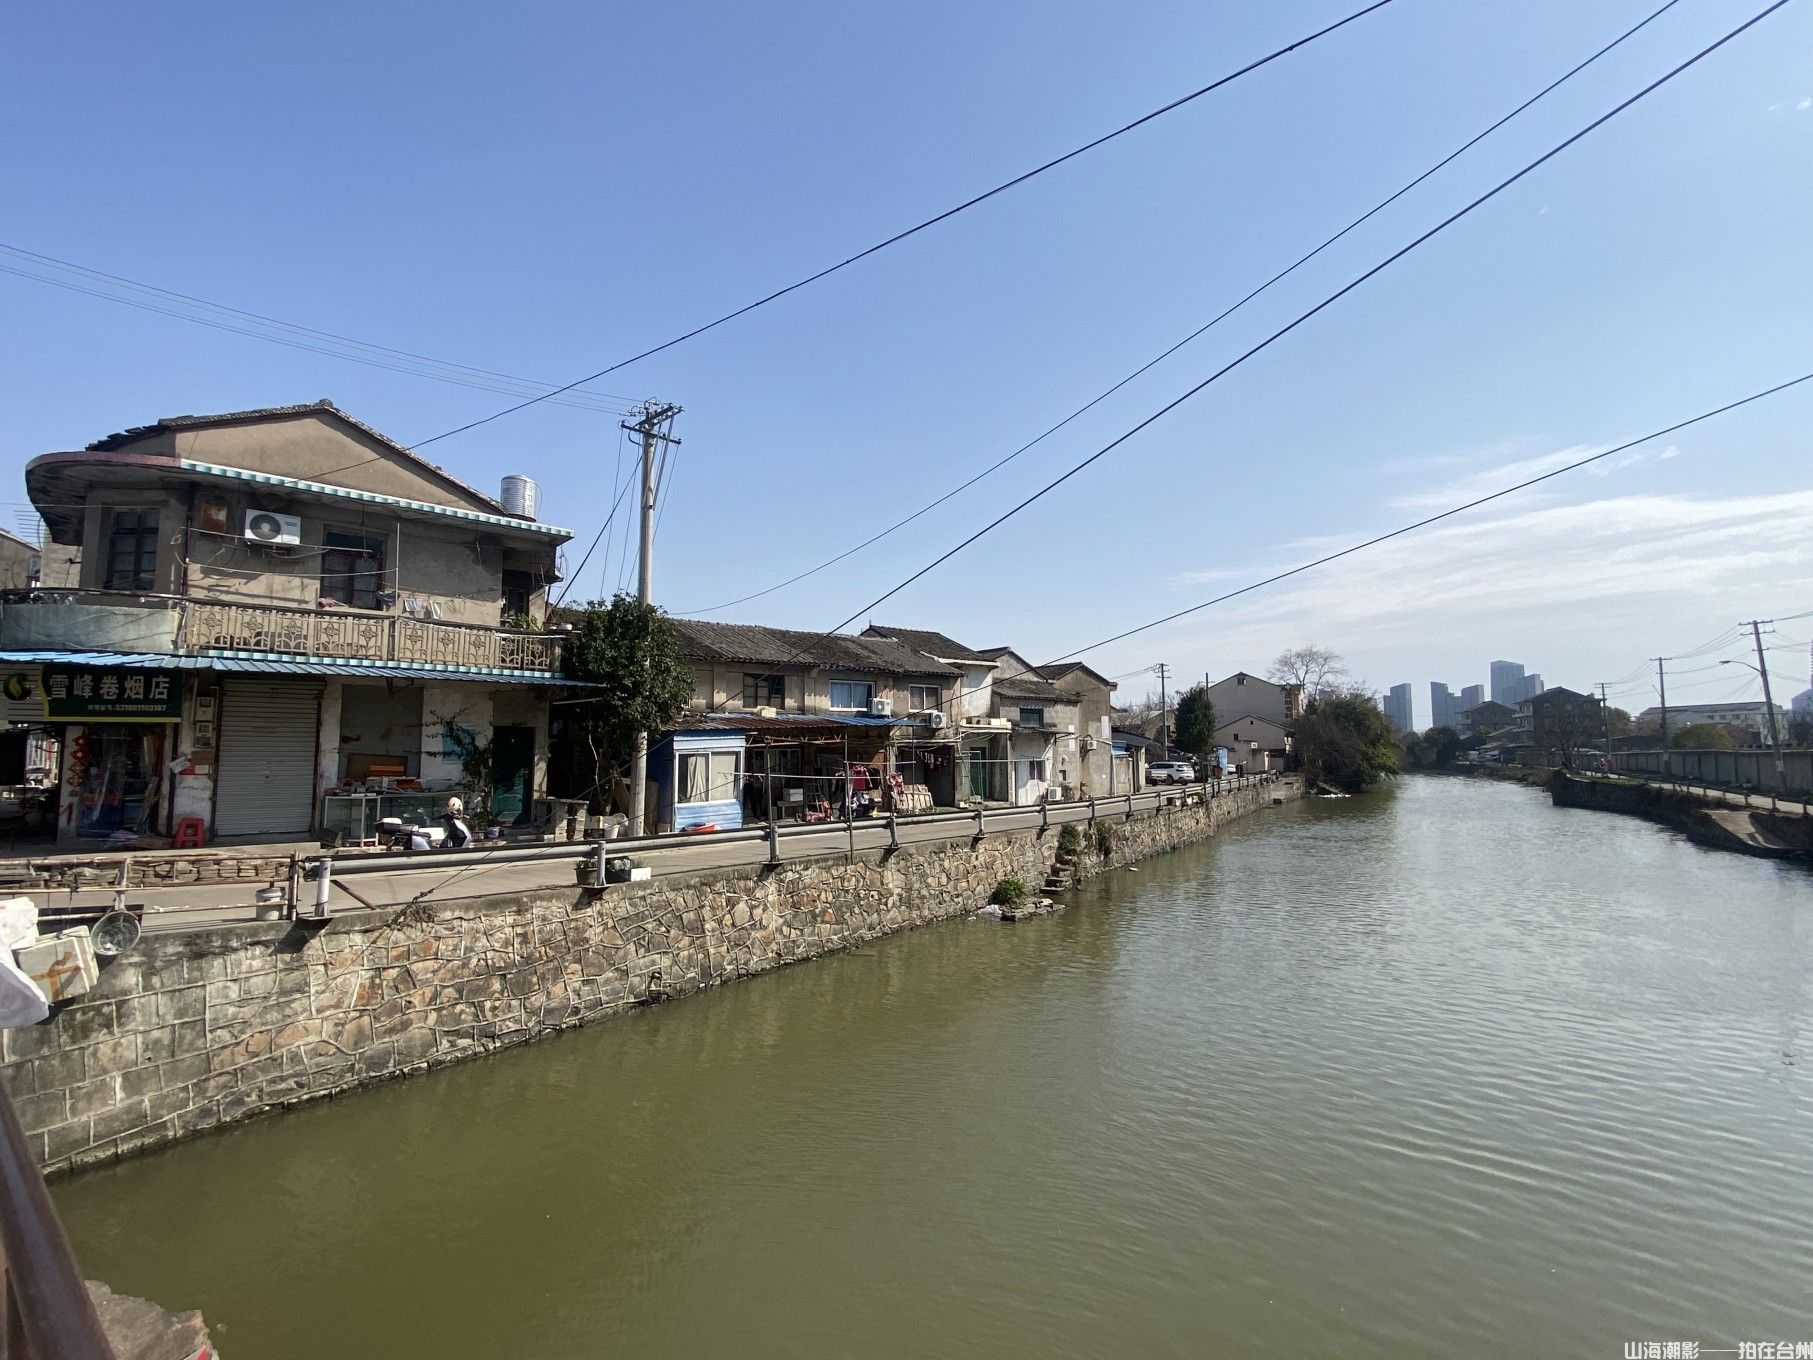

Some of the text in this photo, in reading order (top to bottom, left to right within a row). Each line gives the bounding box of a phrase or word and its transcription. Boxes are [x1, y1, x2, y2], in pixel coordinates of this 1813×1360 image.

[49, 674, 171, 700] 雪峰卷烟店
